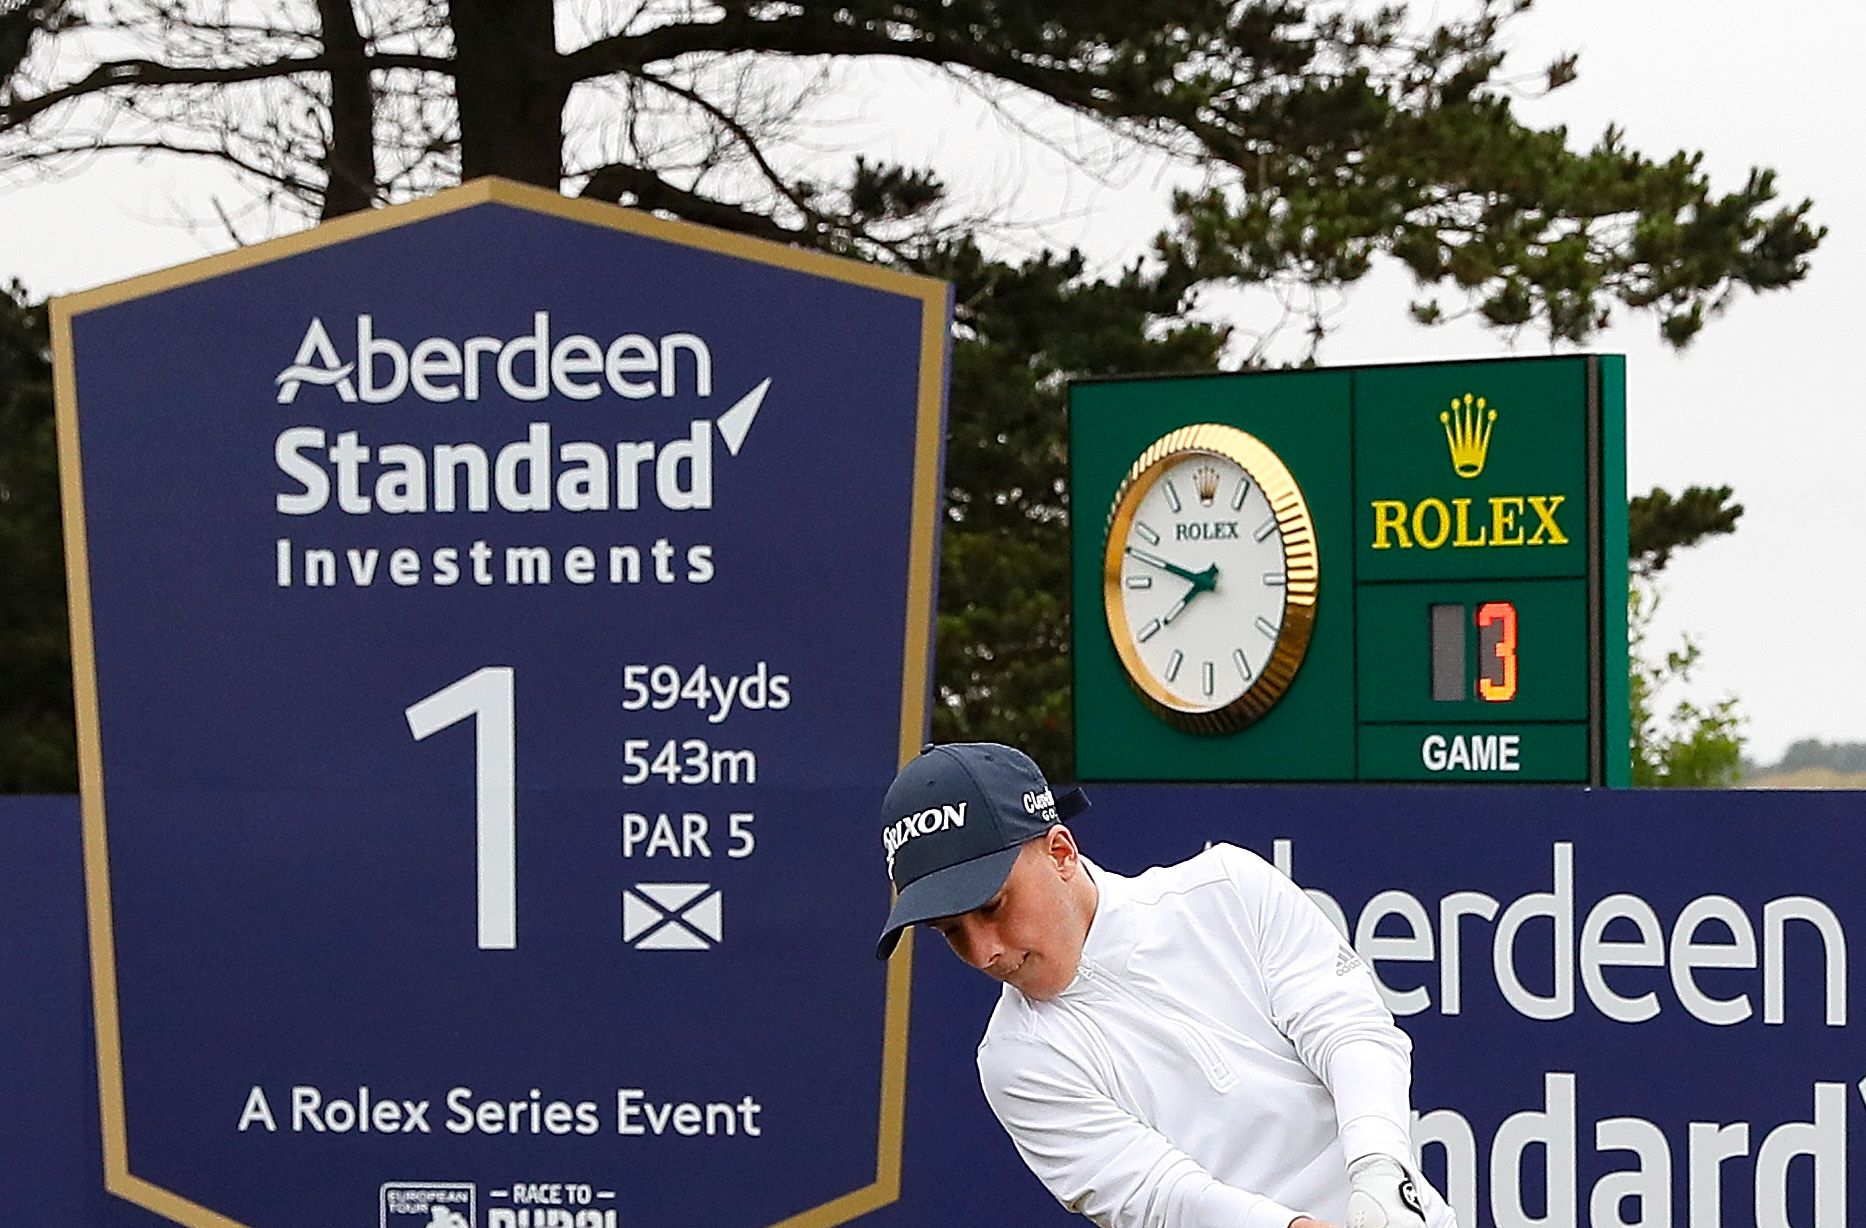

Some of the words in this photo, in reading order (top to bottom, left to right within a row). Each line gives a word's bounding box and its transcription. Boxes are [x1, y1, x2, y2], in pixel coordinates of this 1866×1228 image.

[276, 310, 713, 404] Aberdeen
[276, 422, 713, 515] Standard
[1176, 521, 1240, 541] ROLEX
[1371, 496, 1569, 550] ROLEX
[277, 538, 714, 587] Investments
[1476, 601, 1519, 703] 3
[622, 661, 791, 725] 594yds
[622, 739, 757, 785] 543m
[1422, 733, 1520, 772] GAME
[405, 666, 517, 950] 1
[623, 813, 712, 858] PAR
[727, 813, 755, 858] 5
[1273, 838, 1848, 1027] erdeen
[238, 1086, 277, 1132] A
[292, 1086, 431, 1134] Rolex
[446, 1087, 599, 1135] Series
[617, 1089, 763, 1137] Event
[513, 1183, 563, 1205] RACE
[567, 1184, 592, 1205] TO
